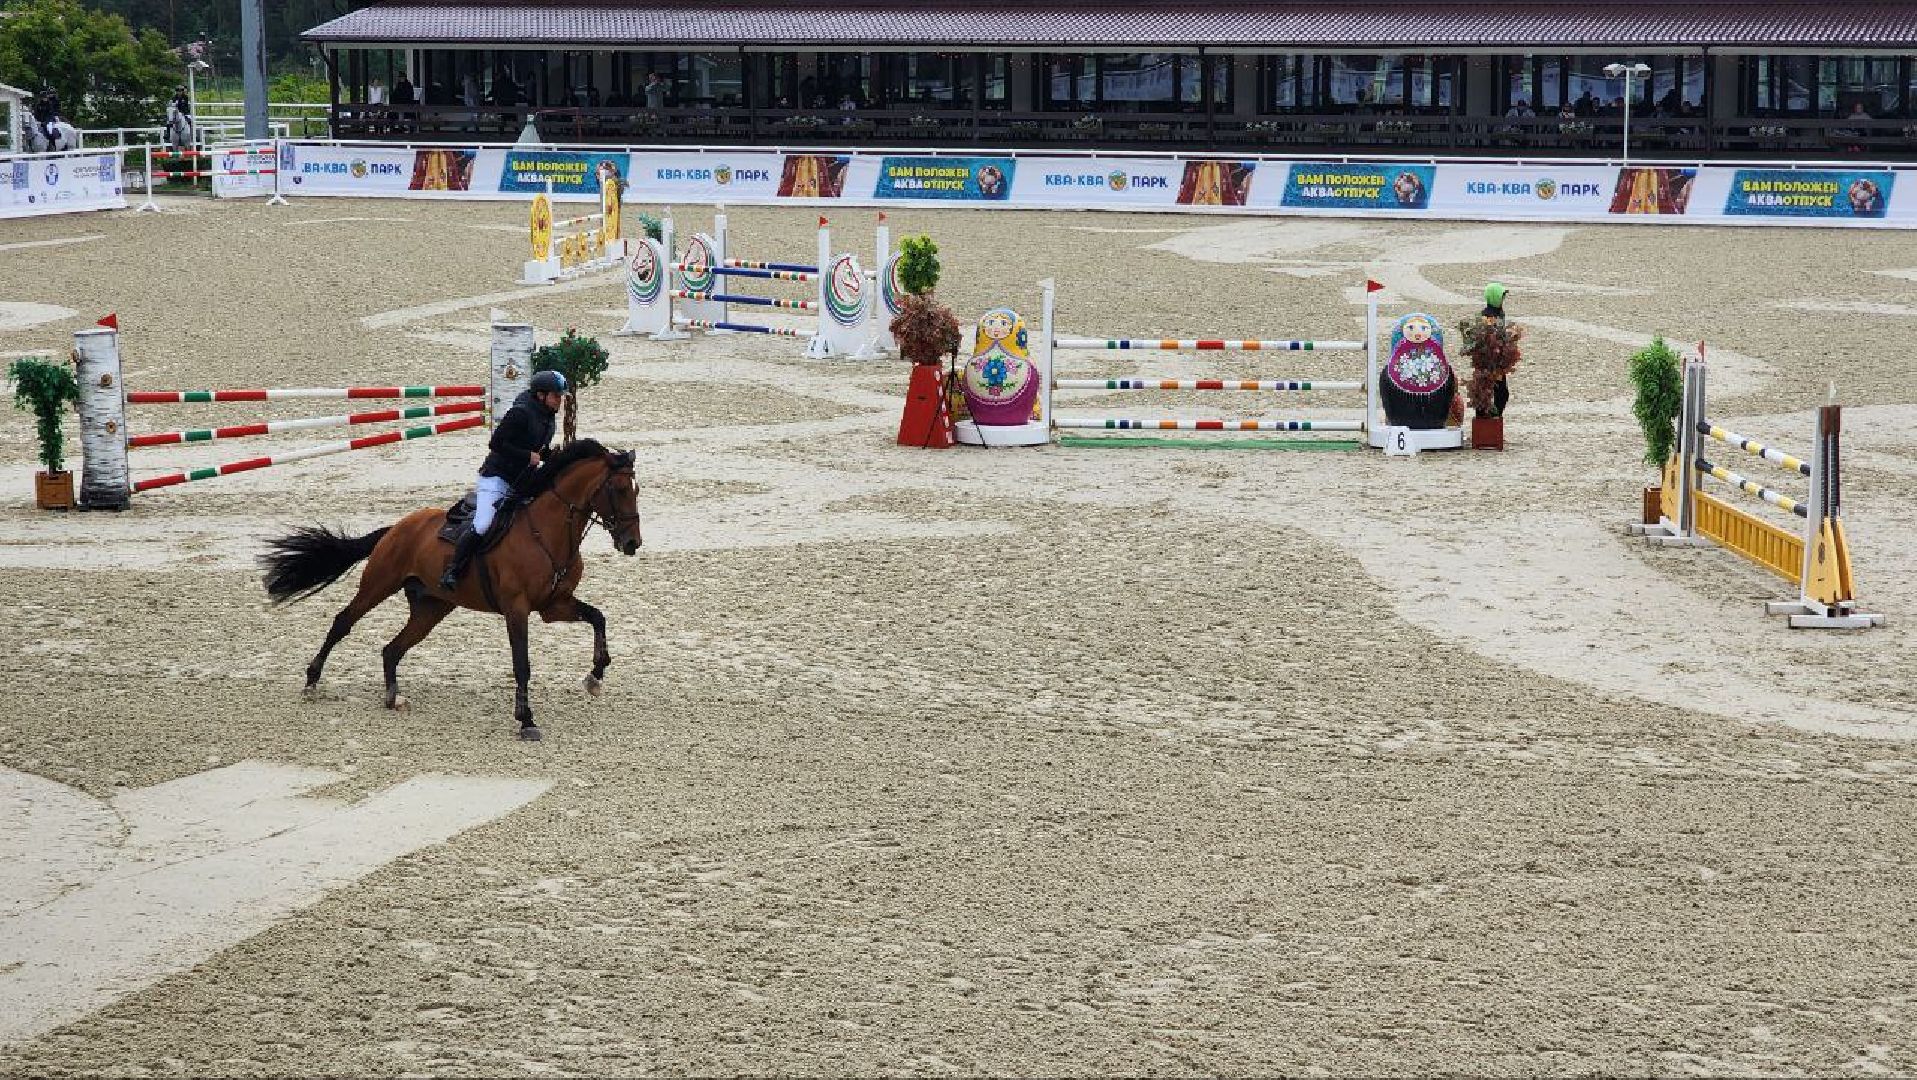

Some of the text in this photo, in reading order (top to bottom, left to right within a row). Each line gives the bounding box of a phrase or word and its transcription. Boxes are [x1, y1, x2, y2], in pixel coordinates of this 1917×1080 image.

[302, 163, 402, 174] ВА-КВА ПАРК
[512, 160, 588, 173] ВАМ ПОЛОЖЕН
[888, 166, 969, 178] ВАМ ПОЛОЖЕН
[517, 173, 583, 184] АКВАОТПУСК
[657, 169, 769, 181] КВА-КВА ПАРК
[1045, 174, 1168, 188] КВА-КВА ПАРК
[1297, 174, 1386, 186] ВАМ ПОЛОЖЕН
[894, 179, 965, 190] АКВАОТПУСК
[1467, 182, 1600, 196] КВА-КВА ПАРК
[1743, 181, 1839, 193] ВАМ ПОЛОЖЕН
[1302, 186, 1380, 198] АКВАОТПУСК
[1748, 193, 1833, 206] АКВАОТПУСК
[1397, 431, 1405, 451] 6
